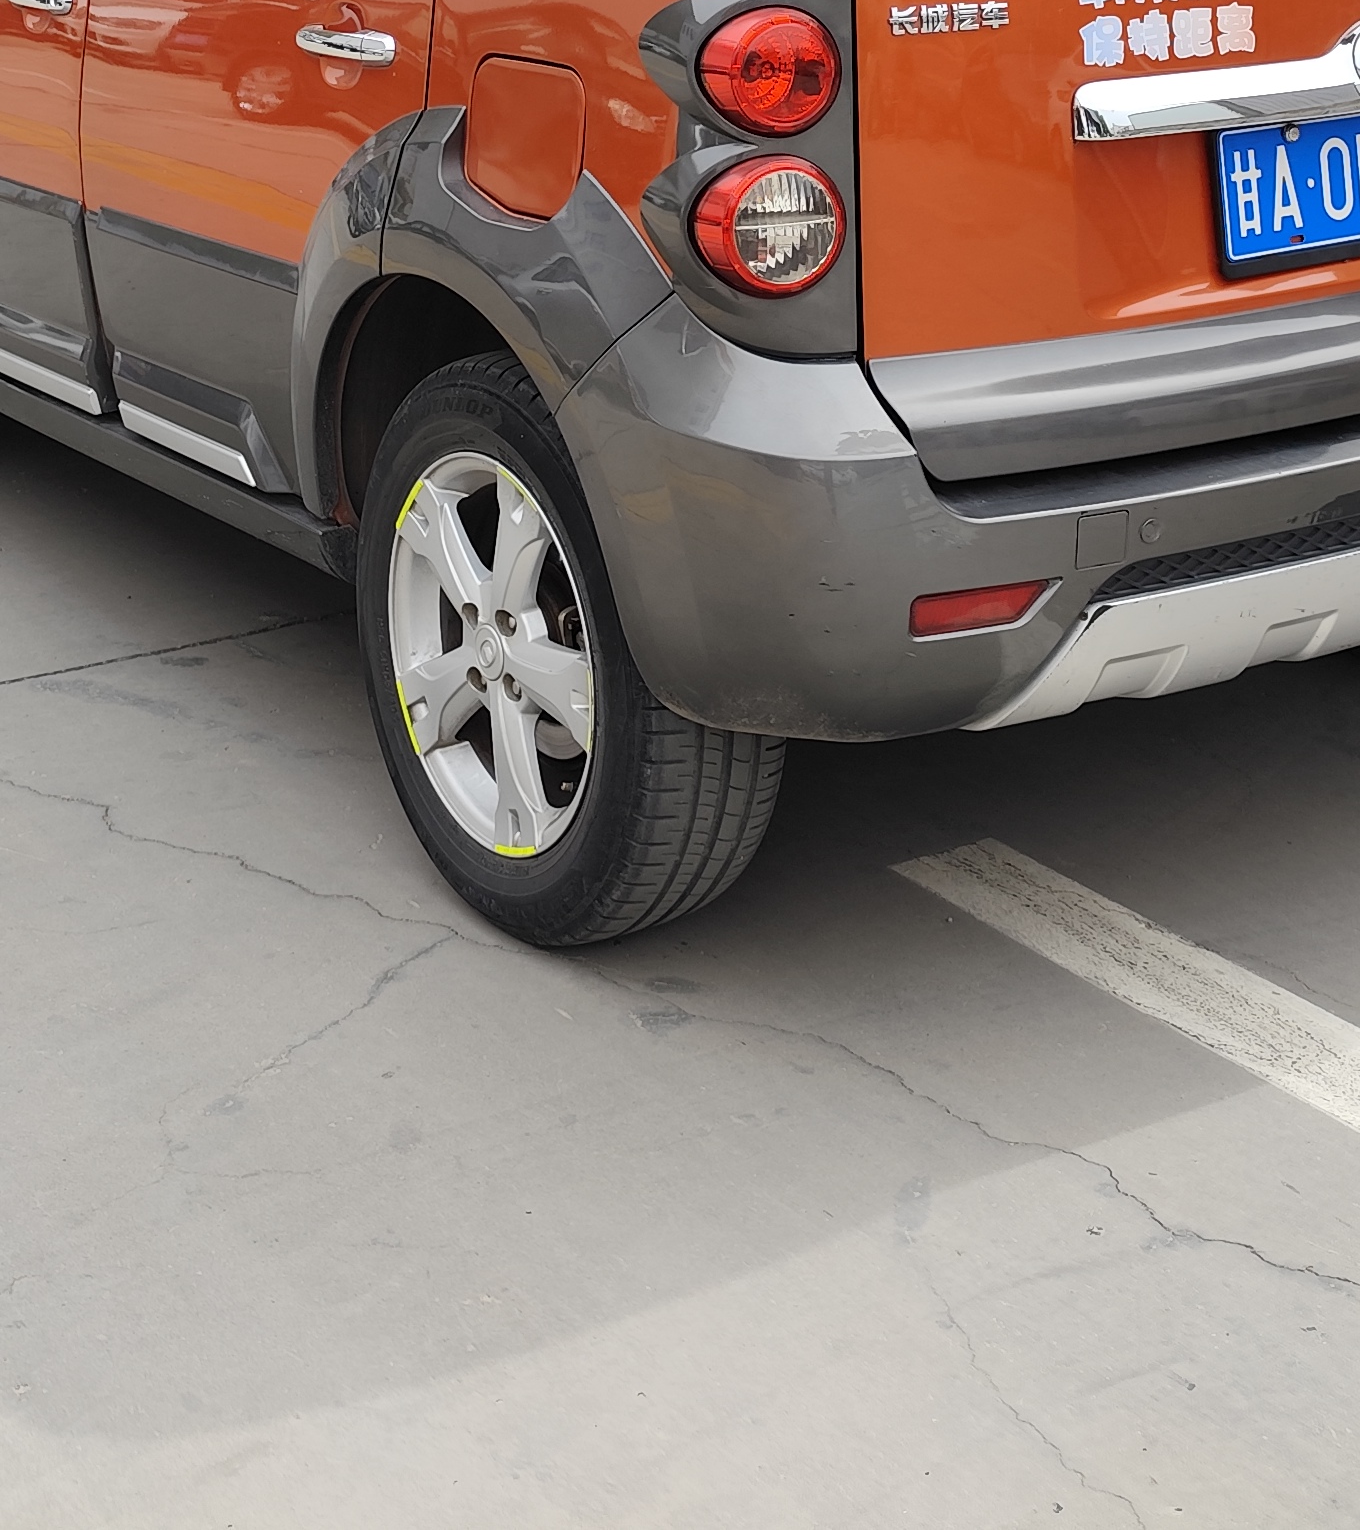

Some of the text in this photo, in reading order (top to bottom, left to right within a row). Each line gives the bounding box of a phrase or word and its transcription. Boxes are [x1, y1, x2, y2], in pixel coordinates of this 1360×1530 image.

[889, 0, 1010, 36] 长城汽车
[1079, 2, 1256, 67] 保持距离
